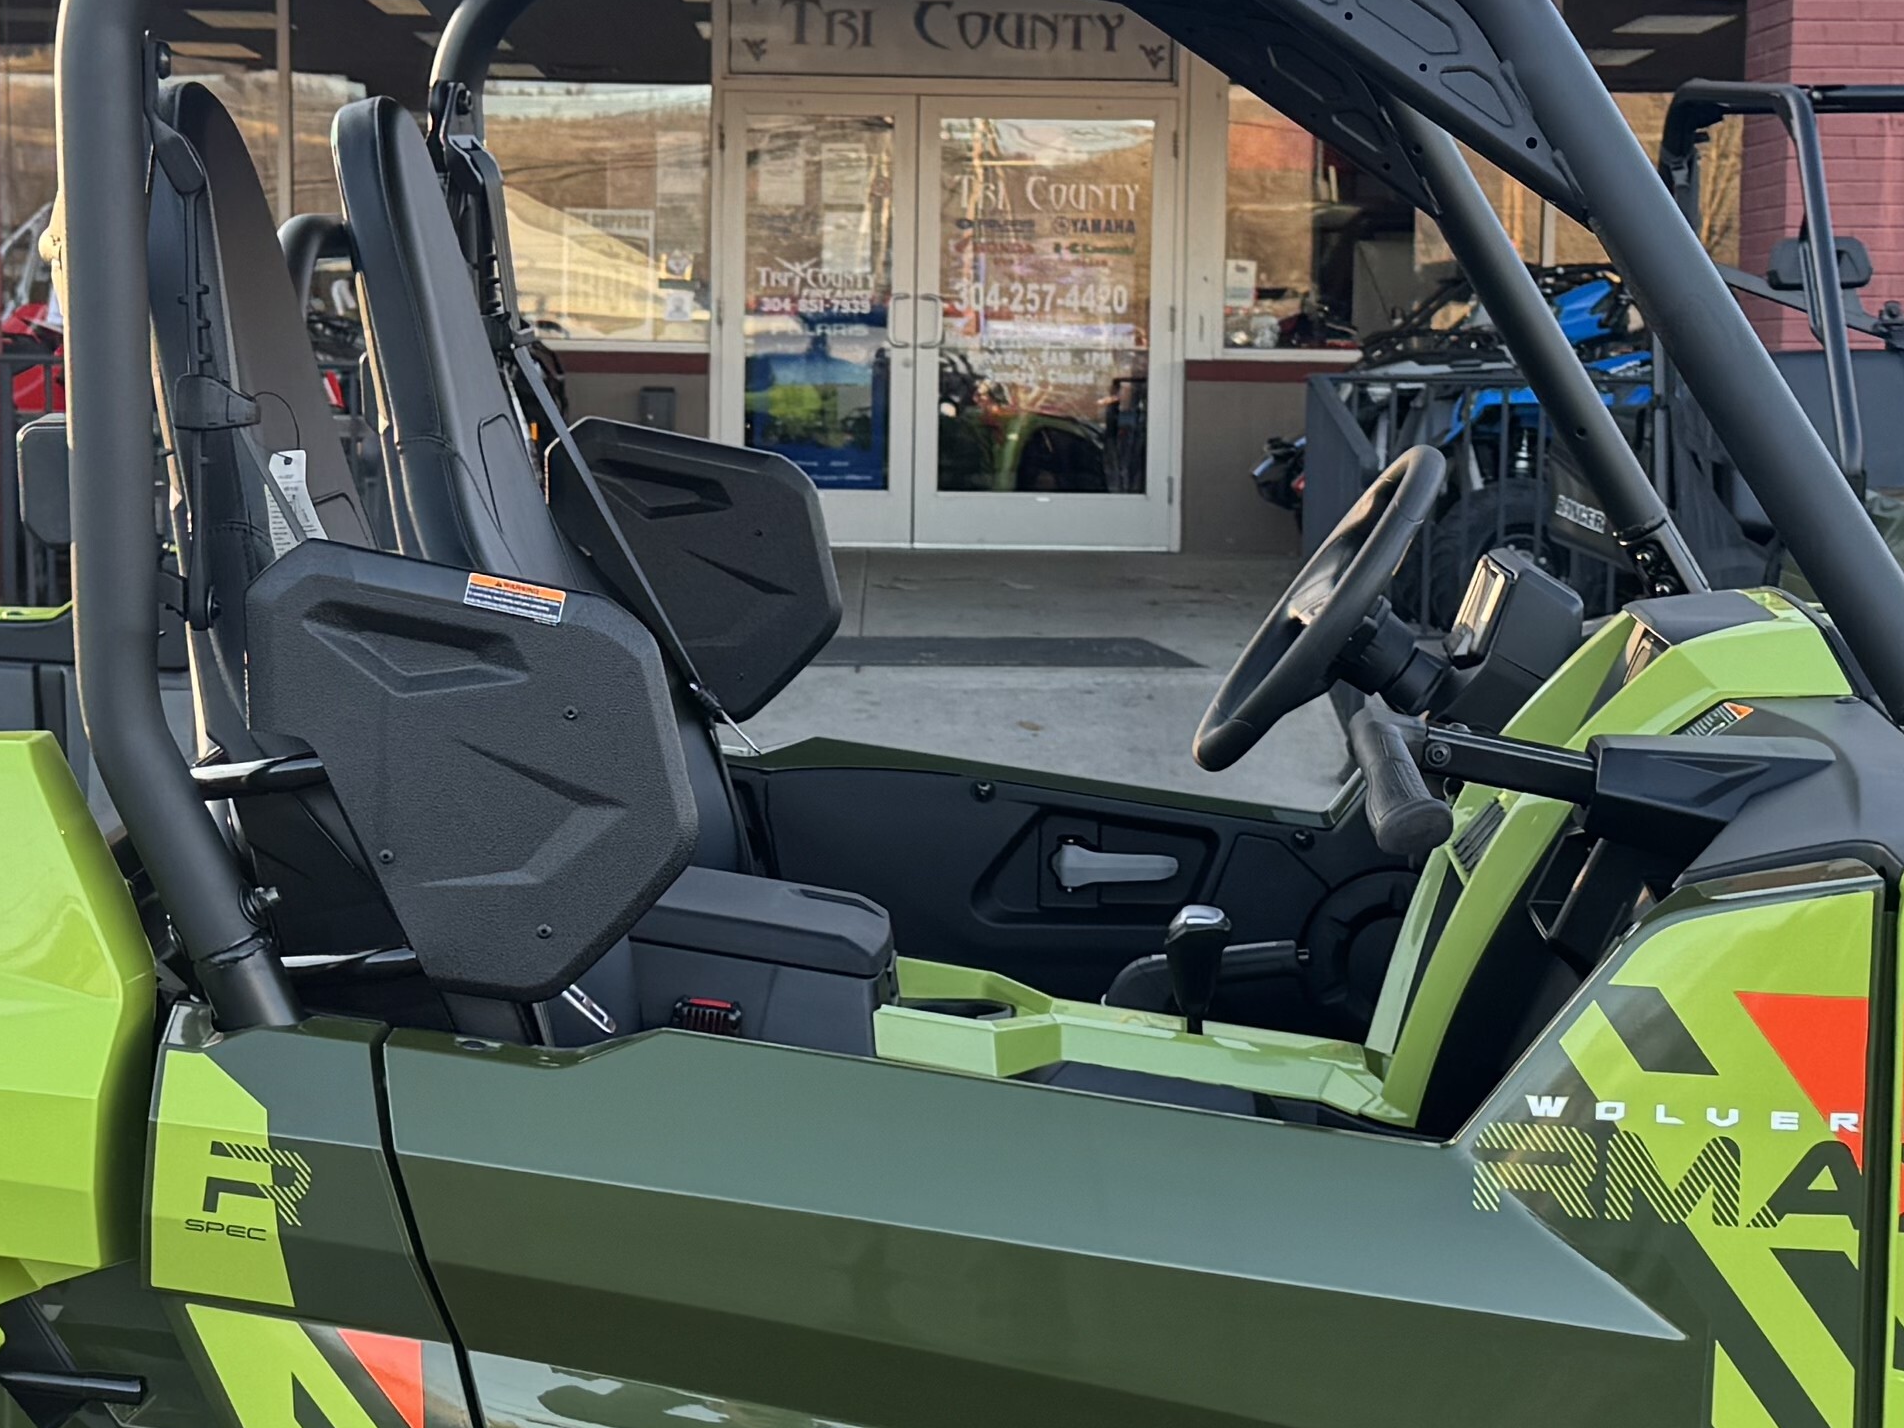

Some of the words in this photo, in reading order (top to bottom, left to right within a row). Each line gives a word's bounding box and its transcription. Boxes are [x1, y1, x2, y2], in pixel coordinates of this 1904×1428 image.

[913, 0, 1126, 53] COUNTY
[1024, 175, 1141, 212] COUNTY
[954, 281, 1129, 315] 304-257-4420
[184, 1218, 267, 1242] SPEC
